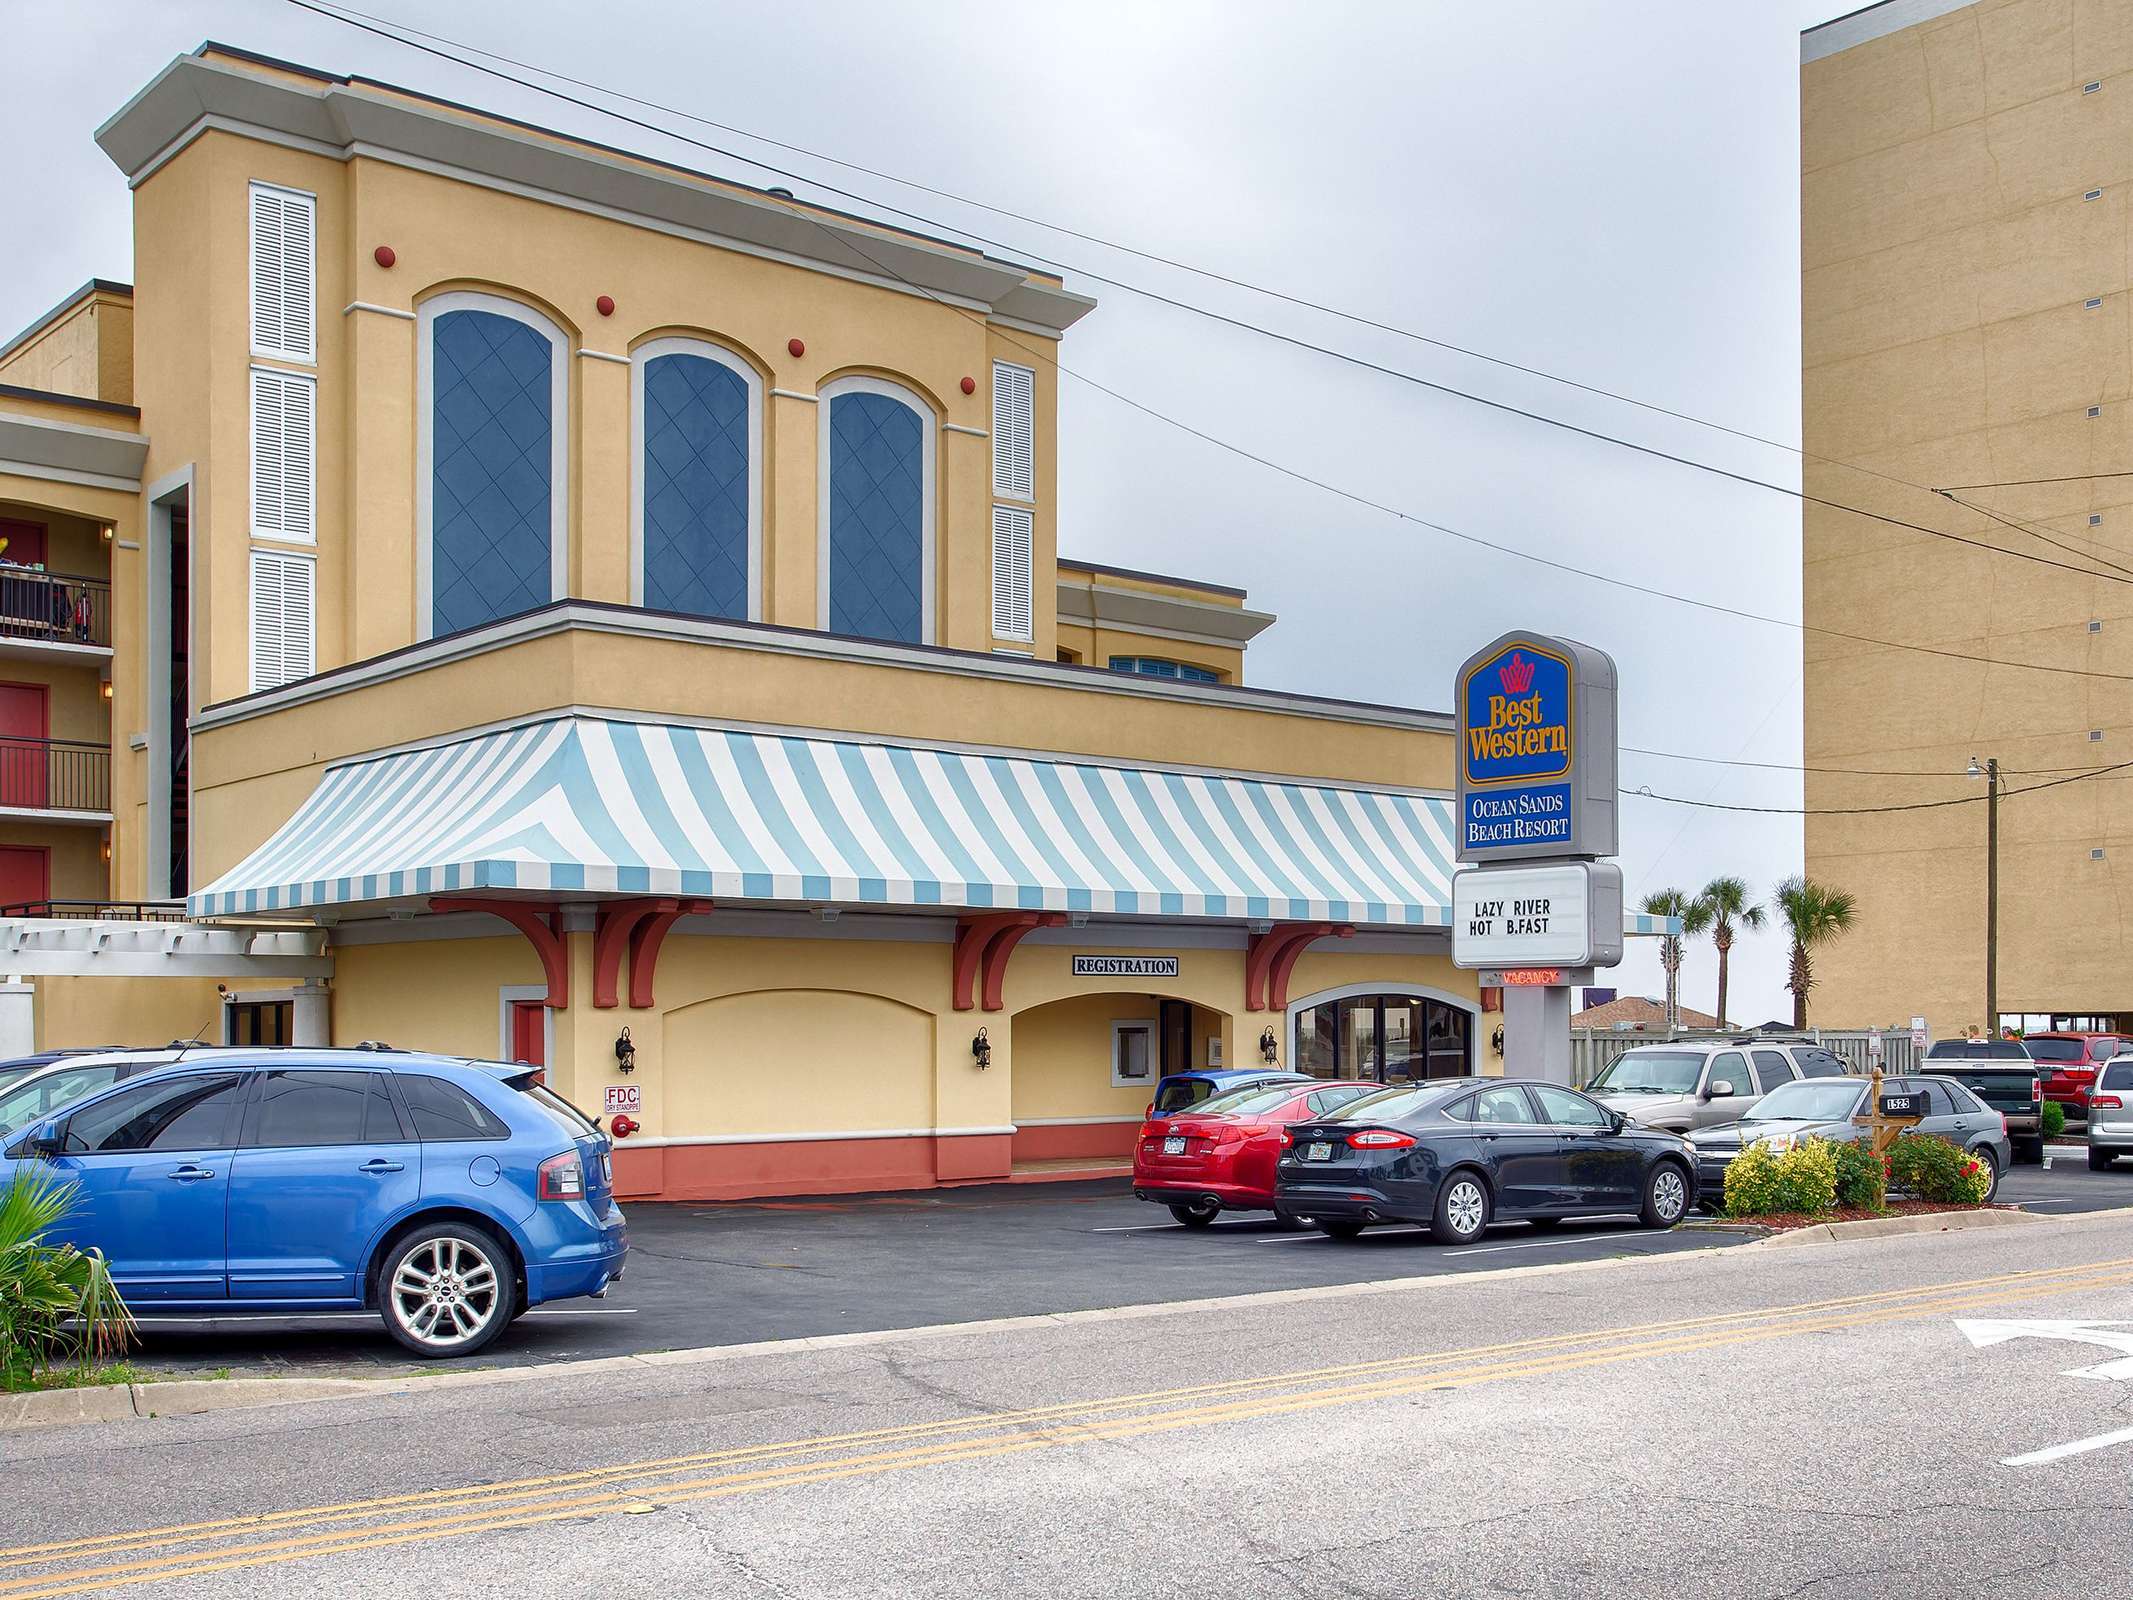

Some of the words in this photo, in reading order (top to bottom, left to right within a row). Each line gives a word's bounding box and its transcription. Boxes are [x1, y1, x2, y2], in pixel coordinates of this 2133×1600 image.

[1489, 690, 1543, 729] Best
[1469, 717, 1567, 760] Western
[1473, 798, 1516, 819] OCEAN
[1519, 794, 1563, 815] SANDS
[1468, 822, 1511, 842] BEACH
[1513, 818, 1568, 839] RESORT
[1475, 901, 1504, 917] LAZY
[1514, 899, 1550, 916] RIVER
[1470, 920, 1492, 935] HOT
[1507, 918, 1549, 934] B.FAST
[1077, 958, 1175, 973] REGISTRATION
[1503, 970, 1559, 984] VACANCY
[608, 1088, 636, 1103] FDC
[1888, 1099, 1909, 1109] 1525
